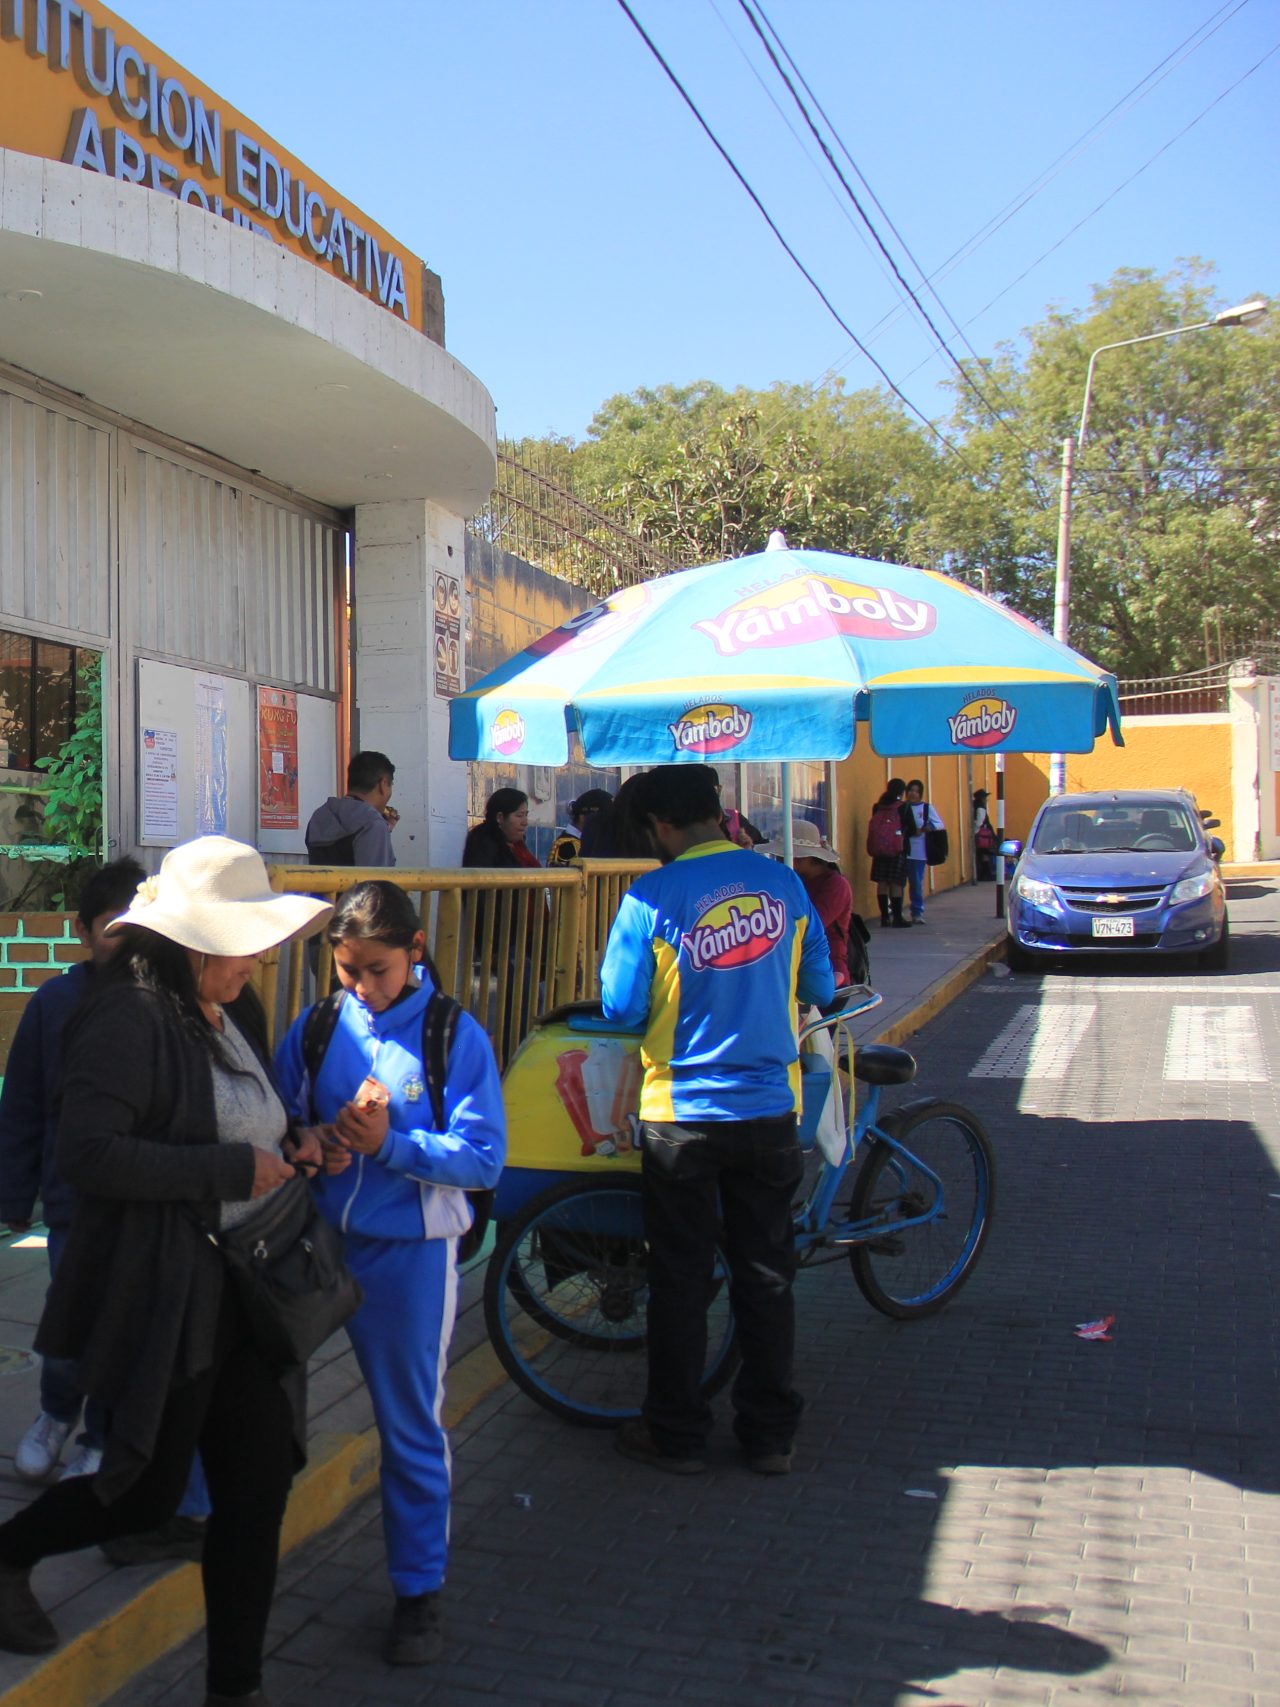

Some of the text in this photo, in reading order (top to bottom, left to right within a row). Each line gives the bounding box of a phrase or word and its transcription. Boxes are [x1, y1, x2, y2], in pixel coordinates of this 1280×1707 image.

[236, 129, 409, 320] EDUCATIVA
[692, 578, 932, 655] Yámboly
[261, 706, 297, 725] KUNG FU
[683, 694, 723, 711] HELADOS
[962, 688, 996, 704] HELADOS
[670, 704, 752, 750] Yámboly
[949, 700, 1016, 744] Yámboly
[695, 882, 745, 913] HELADOS
[683, 889, 785, 971] Yámboly
